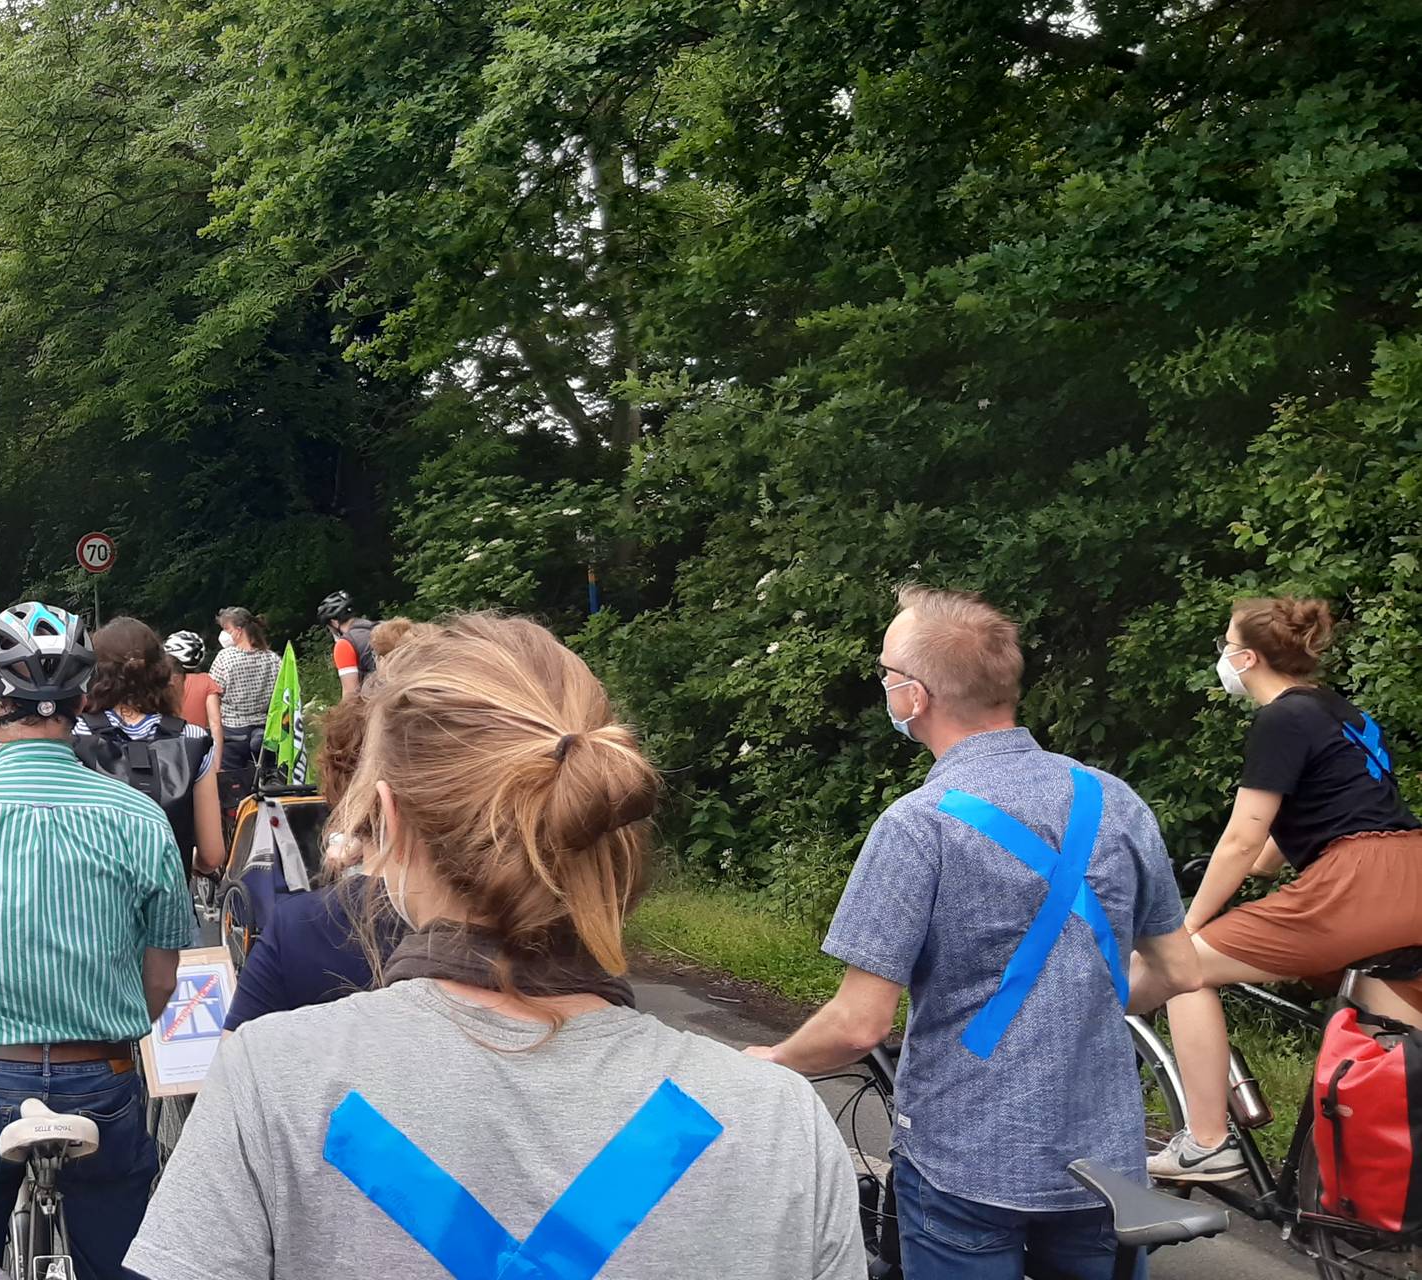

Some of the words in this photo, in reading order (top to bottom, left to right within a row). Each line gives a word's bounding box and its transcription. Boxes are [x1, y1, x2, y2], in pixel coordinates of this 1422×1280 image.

[87, 544, 108, 562] 70
[34, 1125, 52, 1133] SELLE
[53, 1124, 72, 1132] ROYAL
